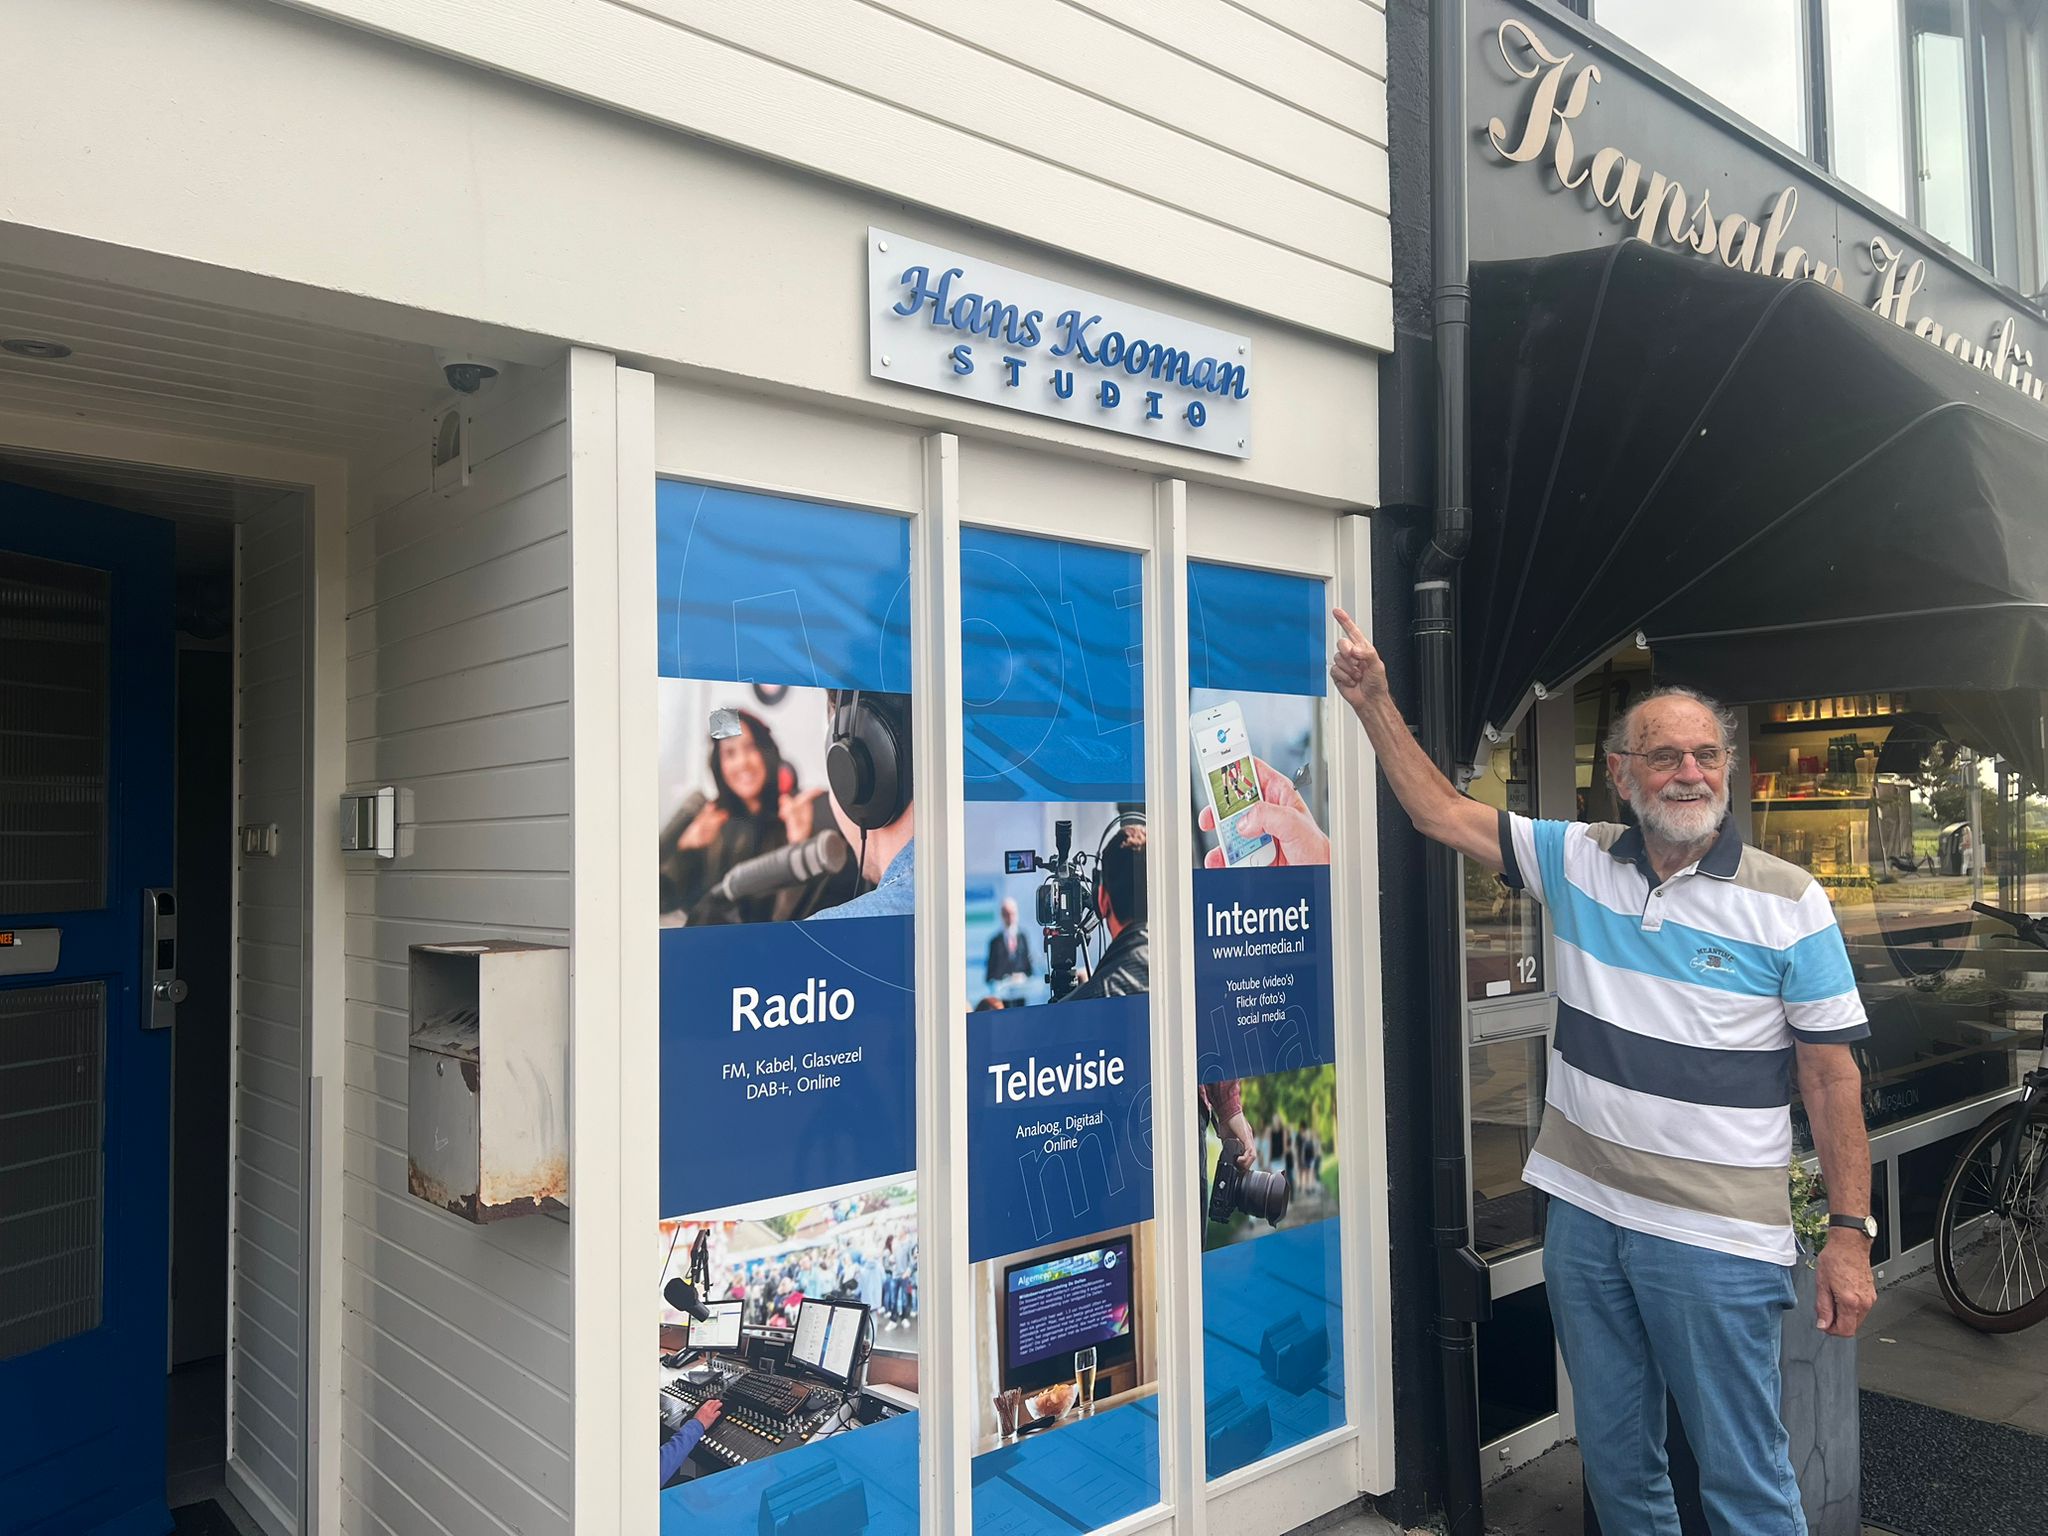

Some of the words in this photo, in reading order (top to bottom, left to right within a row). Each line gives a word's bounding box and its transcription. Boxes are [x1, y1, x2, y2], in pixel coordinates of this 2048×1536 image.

[892, 265, 1044, 348] Hans
[1049, 309, 1250, 400] Kooman
[1870, 235, 2048, 401] Haarli
[951, 343, 1207, 428] STUDIO
[1207, 897, 1310, 937] Internet
[1212, 936, 1305, 960] www.loemedia.nl
[1226, 977, 1261, 992] Youtube
[1516, 955, 1537, 983] 12
[732, 977, 856, 1032] Radio
[1236, 994, 1258, 1009] Flickr
[1237, 1011, 1260, 1026] social
[1261, 1008, 1286, 1023] media
[722, 1062, 750, 1081] FM,
[756, 1055, 798, 1076] Kabel,
[802, 1046, 862, 1070] Glasvezel
[988, 1049, 1125, 1104] Televisie
[746, 1081, 792, 1100] DAB+,
[797, 1074, 841, 1092] Online
[1015, 1120, 1062, 1140] Analoog,
[1065, 1109, 1103, 1132] Digitaal
[1043, 1136, 1078, 1154] Online
